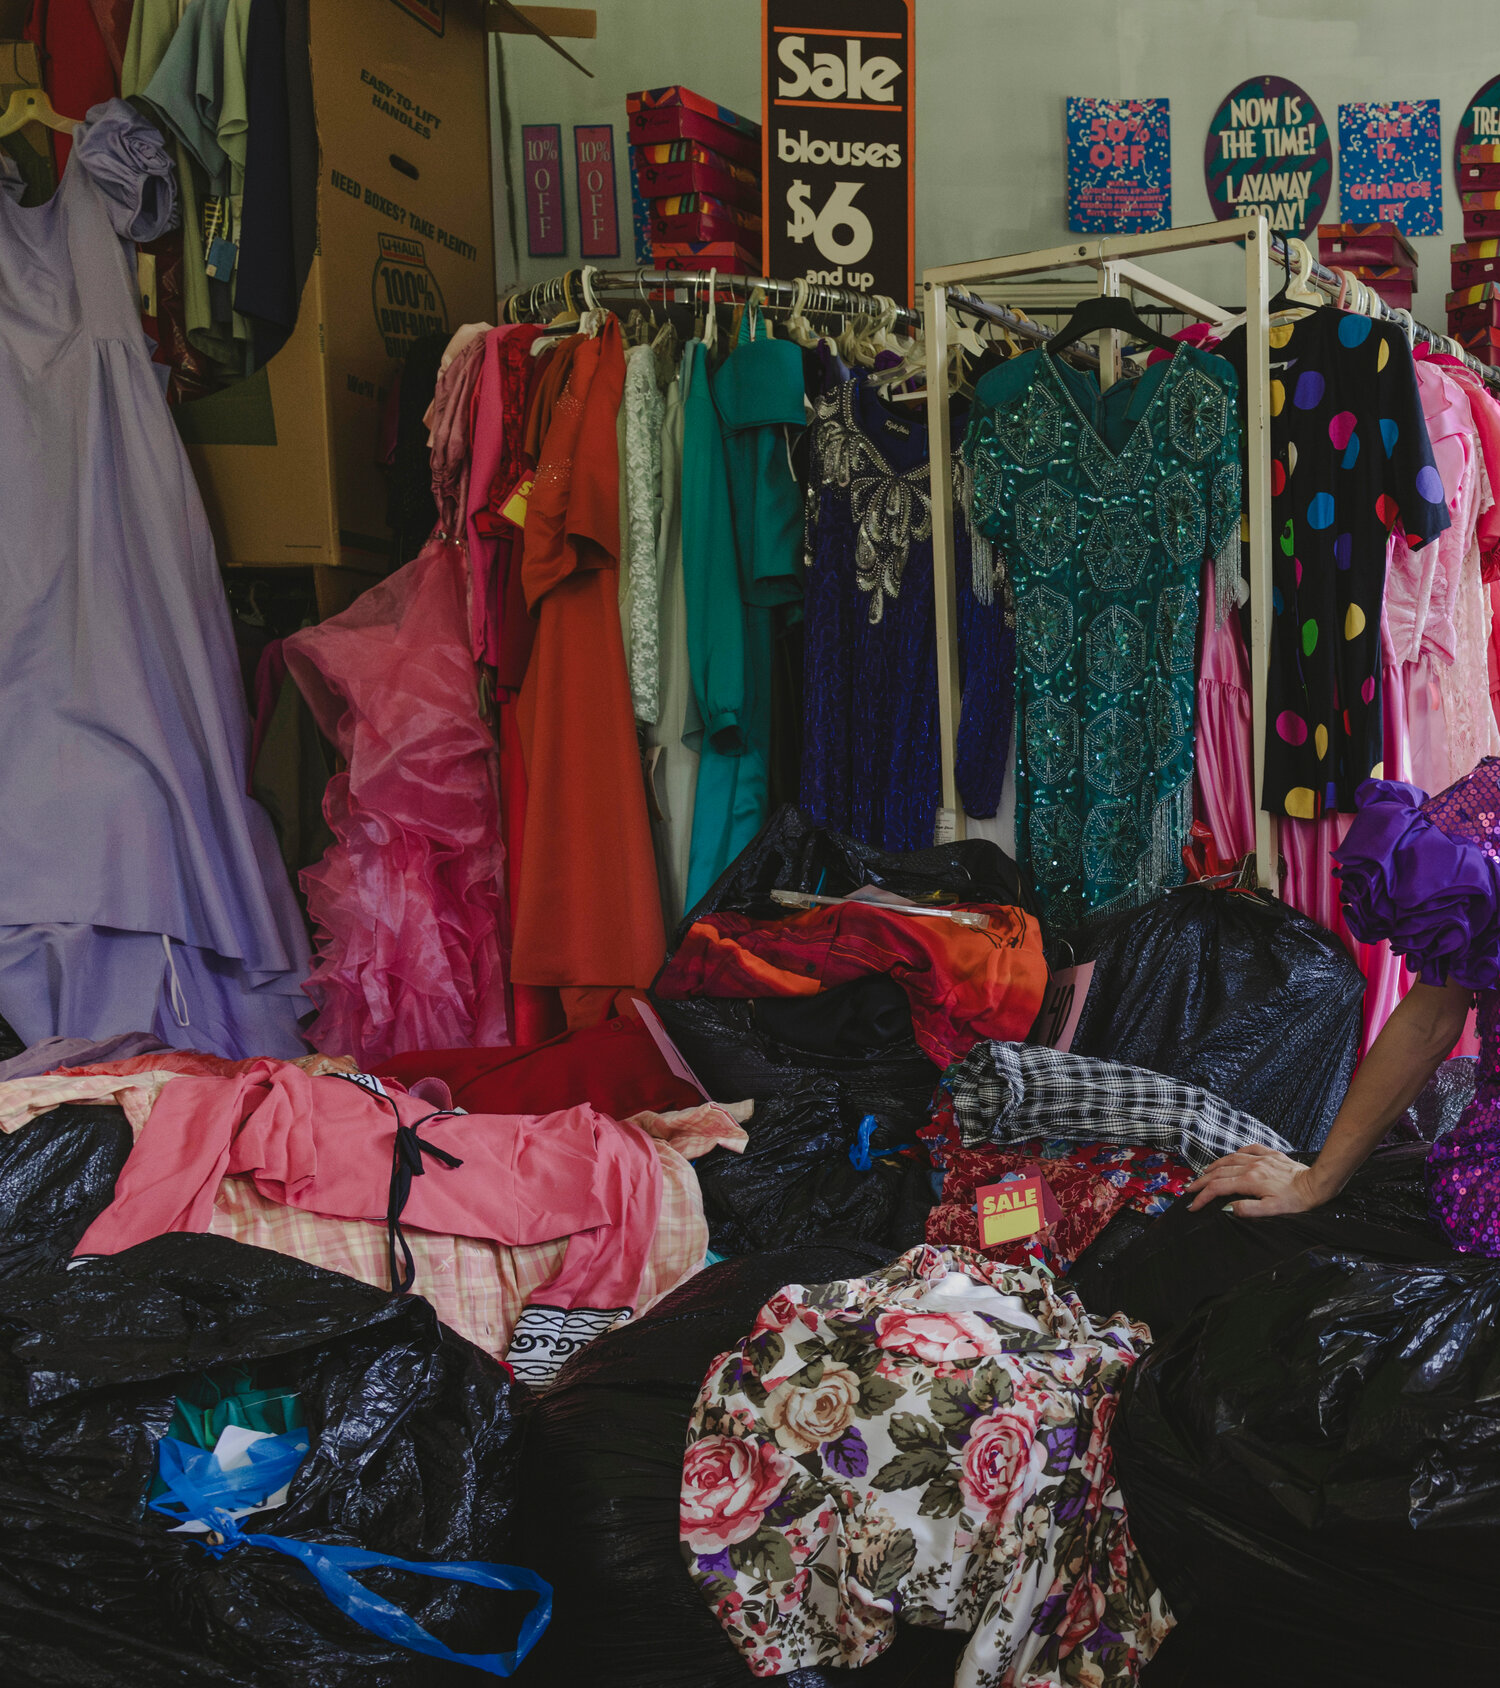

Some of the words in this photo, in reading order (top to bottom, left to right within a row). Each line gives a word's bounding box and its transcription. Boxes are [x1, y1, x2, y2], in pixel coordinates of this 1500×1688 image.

[777, 35, 903, 102] Sale
[360, 68, 442, 130] EASY-TO-LIFT
[1230, 97, 1278, 128] NOW
[1284, 96, 1302, 125] IS
[371, 94, 431, 140] HANDLES
[1090, 119, 1150, 142] 50%
[1367, 121, 1412, 138] LIKE
[527, 139, 558, 162] 10%
[580, 141, 611, 163] 10%
[777, 128, 902, 168] blouses
[1089, 144, 1145, 168] OFF
[1219, 130, 1257, 159] THE
[1262, 123, 1316, 158] TIME!
[1377, 143, 1402, 161] IT,
[534, 168, 551, 238] OFF
[1226, 171, 1312, 203] LAYAWAY
[1349, 181, 1431, 200] CHARGE
[331, 169, 361, 200] NEED
[364, 188, 407, 225] BOXES?
[409, 212, 435, 241] TAKE
[437, 229, 477, 262] PLENTY!
[587, 169, 605, 240] OFF
[1378, 202, 1404, 220] IT!
[786, 179, 873, 265] $6
[381, 238, 423, 257] U-HAUL
[380, 266, 436, 311] 100%
[805, 266, 843, 286] and
[847, 271, 875, 292] up
[1046, 983, 1076, 1048] 40
[982, 1187, 1038, 1215] SALE
